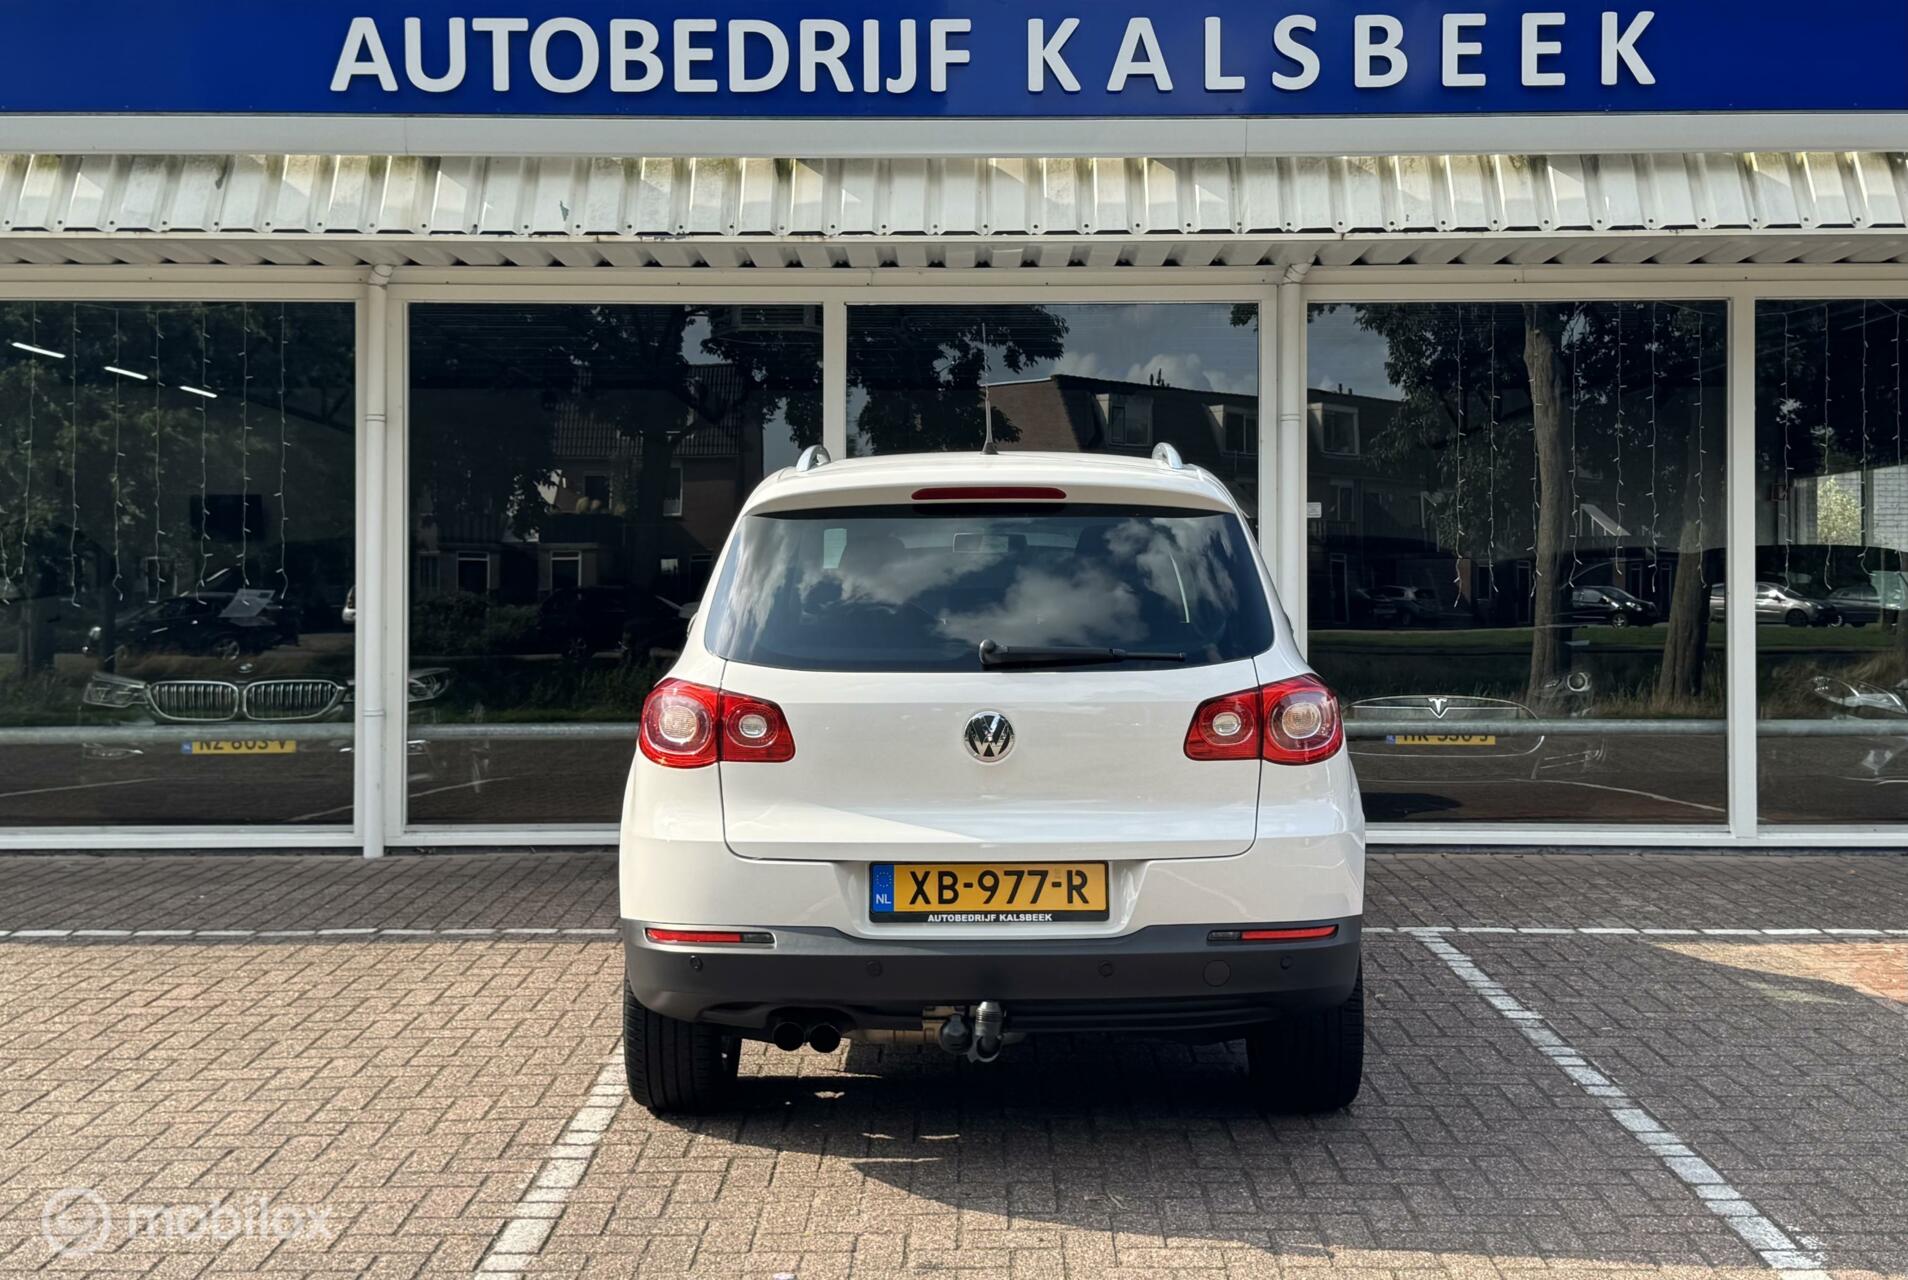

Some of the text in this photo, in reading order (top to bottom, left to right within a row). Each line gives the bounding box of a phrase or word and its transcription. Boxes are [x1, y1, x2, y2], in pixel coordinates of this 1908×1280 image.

[329, 11, 1656, 94] AUTOBEDRIJF KALSBEEK
[875, 869, 1089, 905] NL XB-977-R
[927, 913, 1053, 922] AUTOBEDRIJF KALSBEEK
